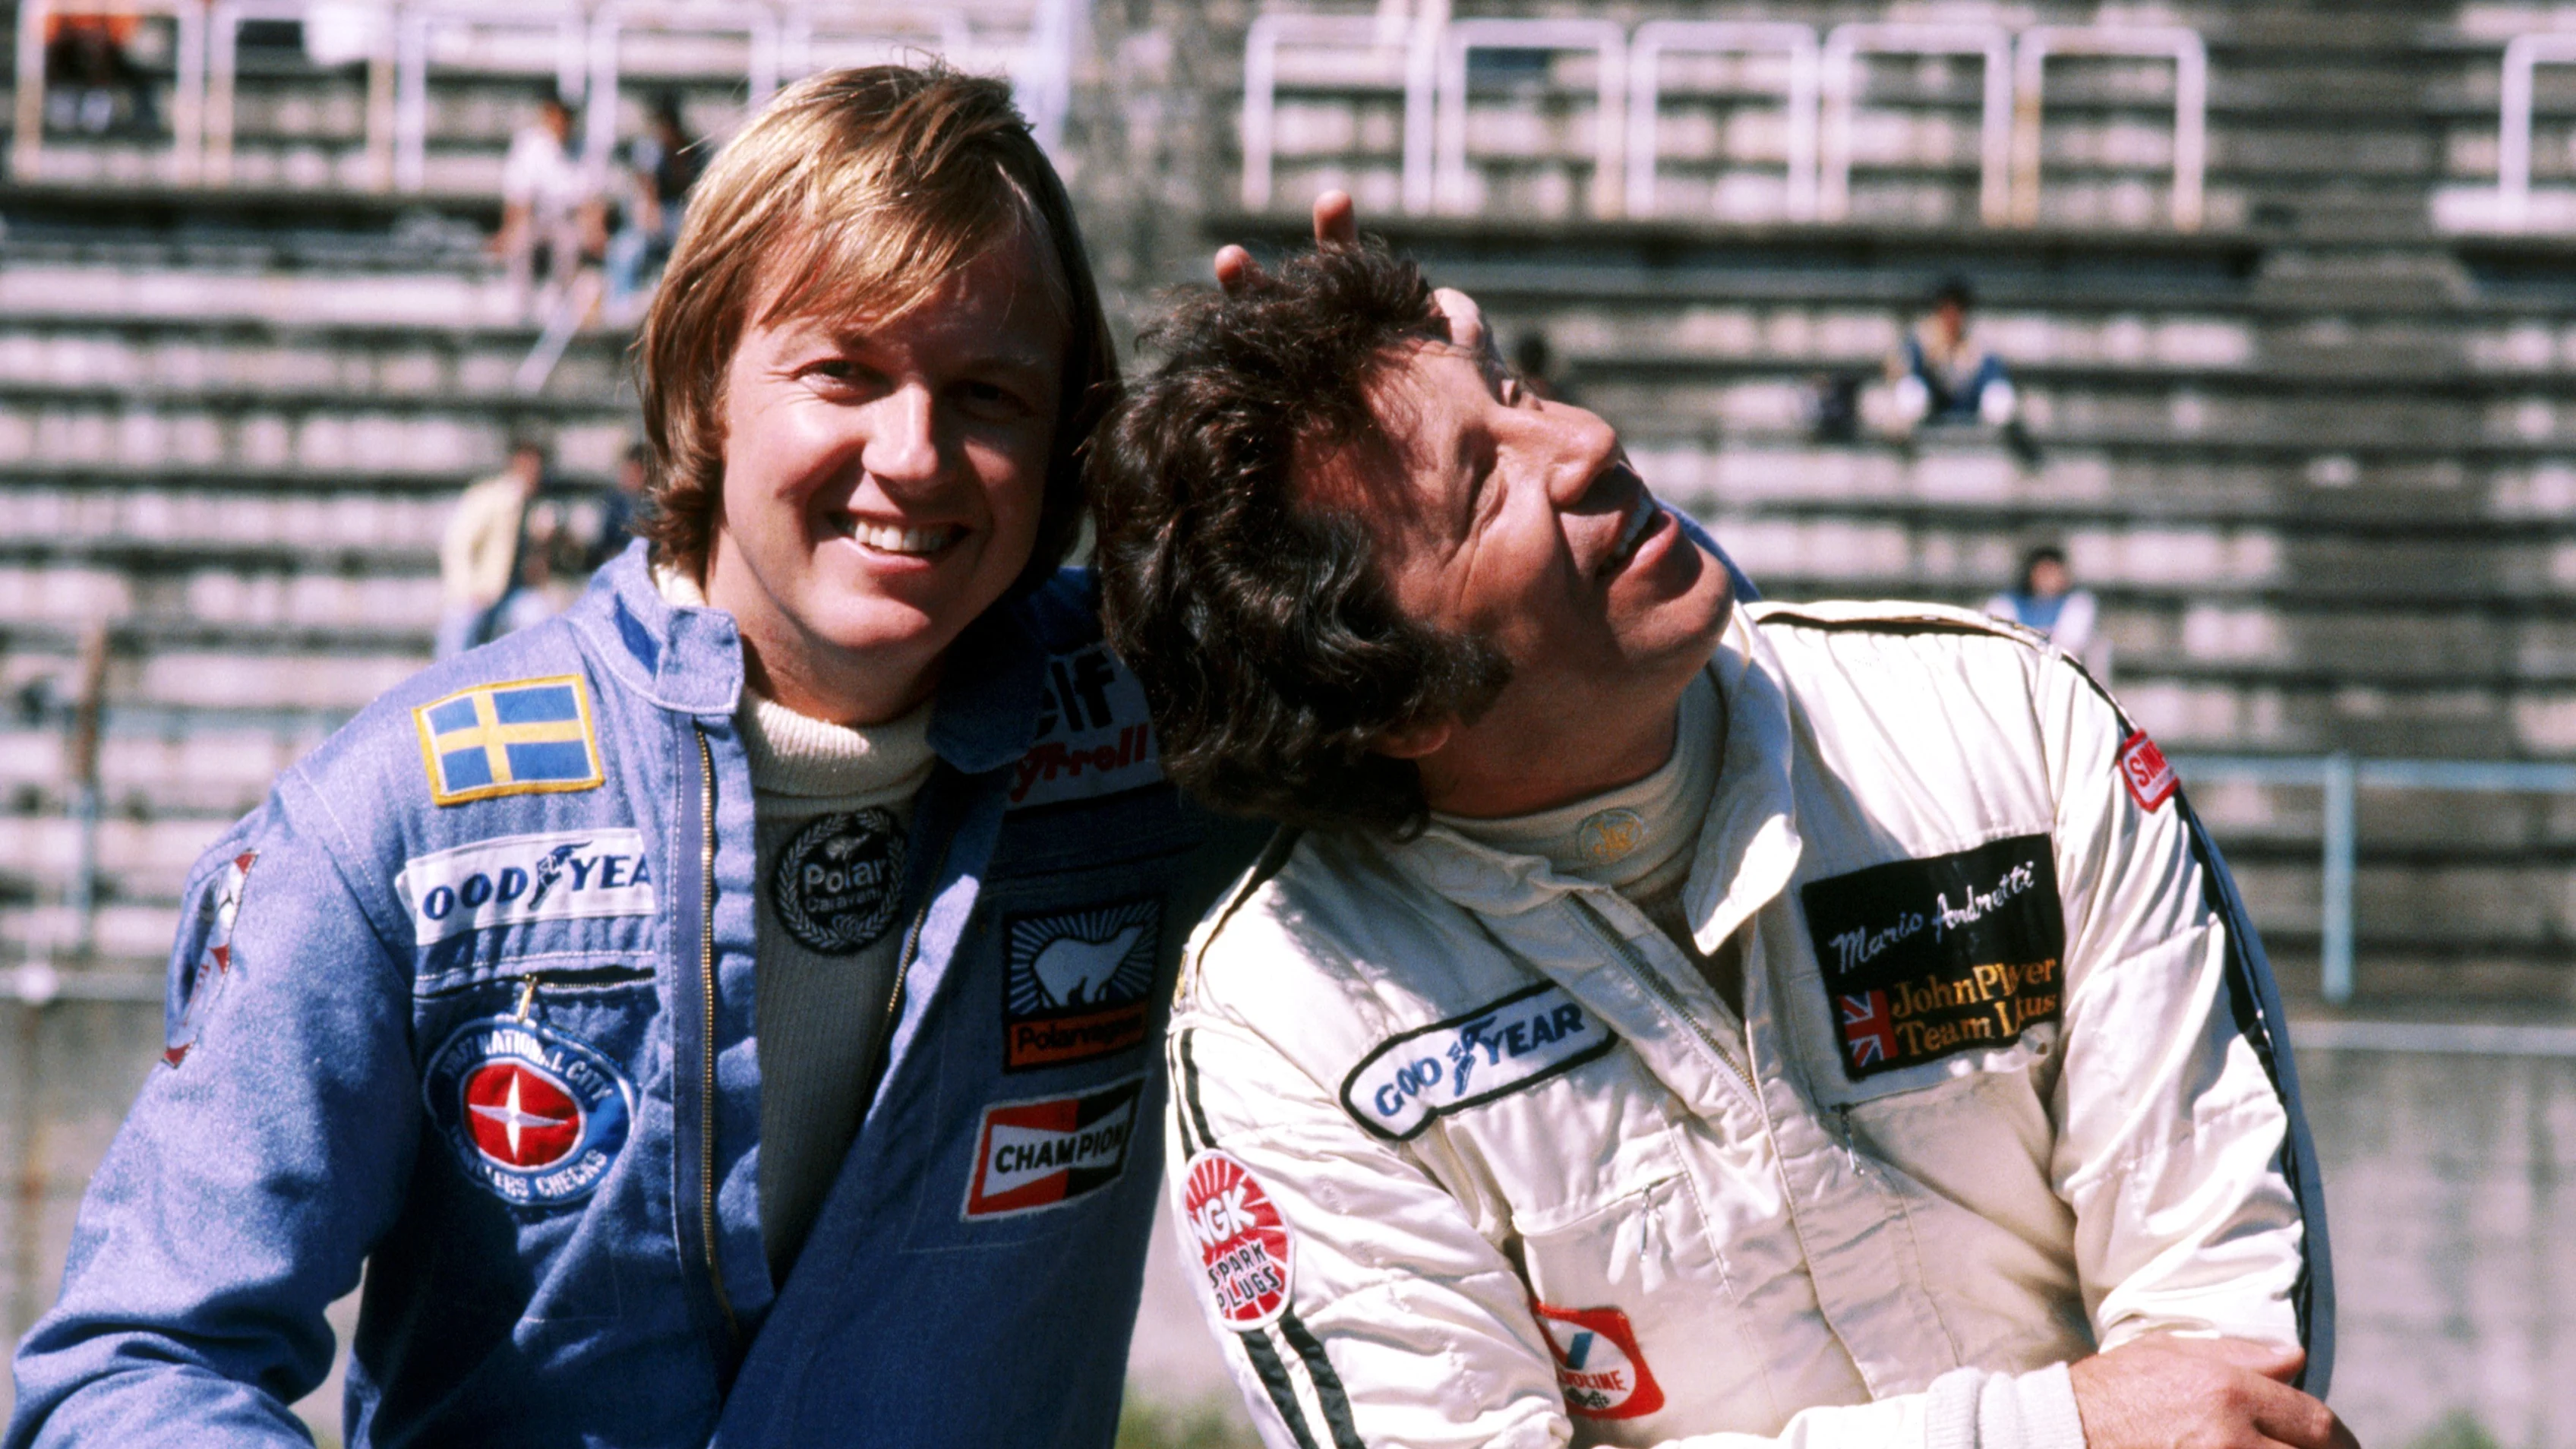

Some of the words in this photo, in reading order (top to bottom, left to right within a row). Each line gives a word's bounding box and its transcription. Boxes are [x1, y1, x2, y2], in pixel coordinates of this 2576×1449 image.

[422, 867, 529, 920] OOD
[569, 854, 652, 892] YEA
[803, 858, 888, 895] Polar
[1828, 912, 1924, 975] Mario
[1931, 860, 2035, 944] Andretti
[1897, 1015, 1997, 1056] Team
[565, 1059, 614, 1102] CITY
[1375, 1056, 1443, 1117] GOD
[535, 1148, 608, 1198] CHECKS
[996, 1122, 1125, 1174] CHAMPION
[1189, 1183, 1257, 1247] NGK
[1208, 1242, 1267, 1290] SPARK
[1217, 1266, 1282, 1309] PLUGS
